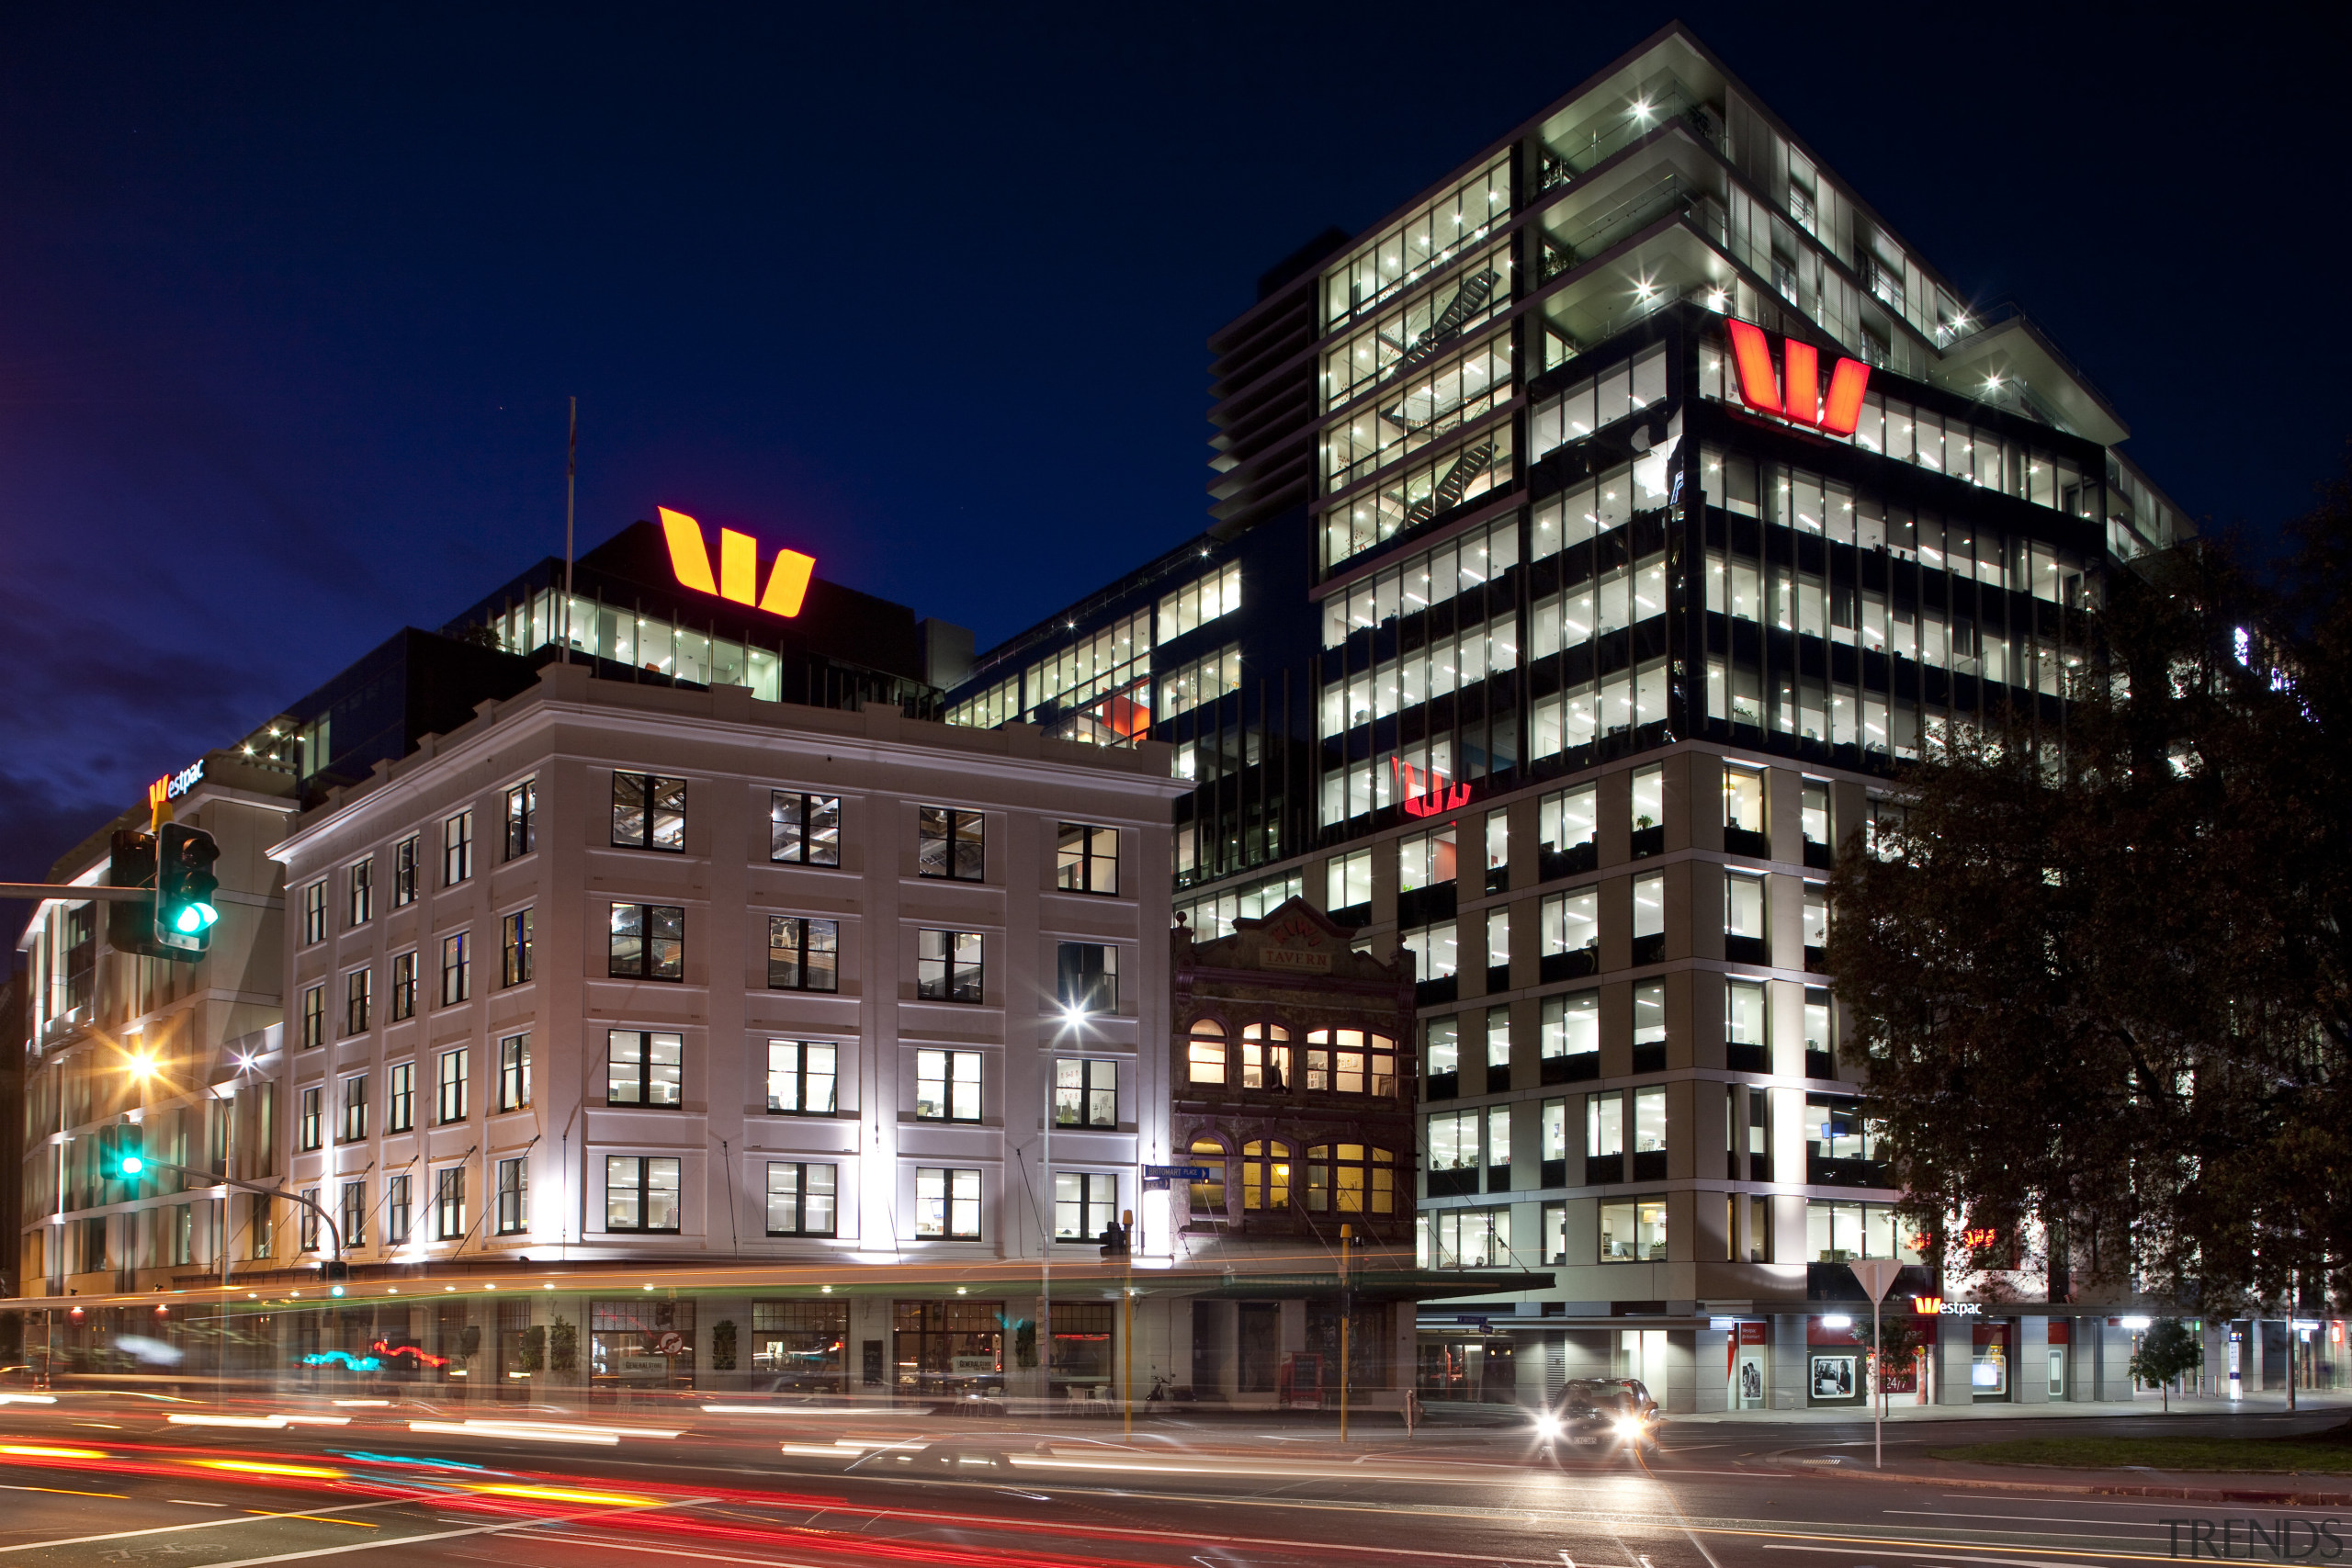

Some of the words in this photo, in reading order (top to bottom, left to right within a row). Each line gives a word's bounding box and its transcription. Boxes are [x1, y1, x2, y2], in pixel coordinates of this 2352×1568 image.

[149, 759, 204, 810] Westpac
[1271, 916, 1322, 947] KIWI
[1266, 950, 1327, 966] TAVERN
[1148, 1167, 1182, 1177] BRITOMART
[1916, 1297, 1982, 1316] Westpac
